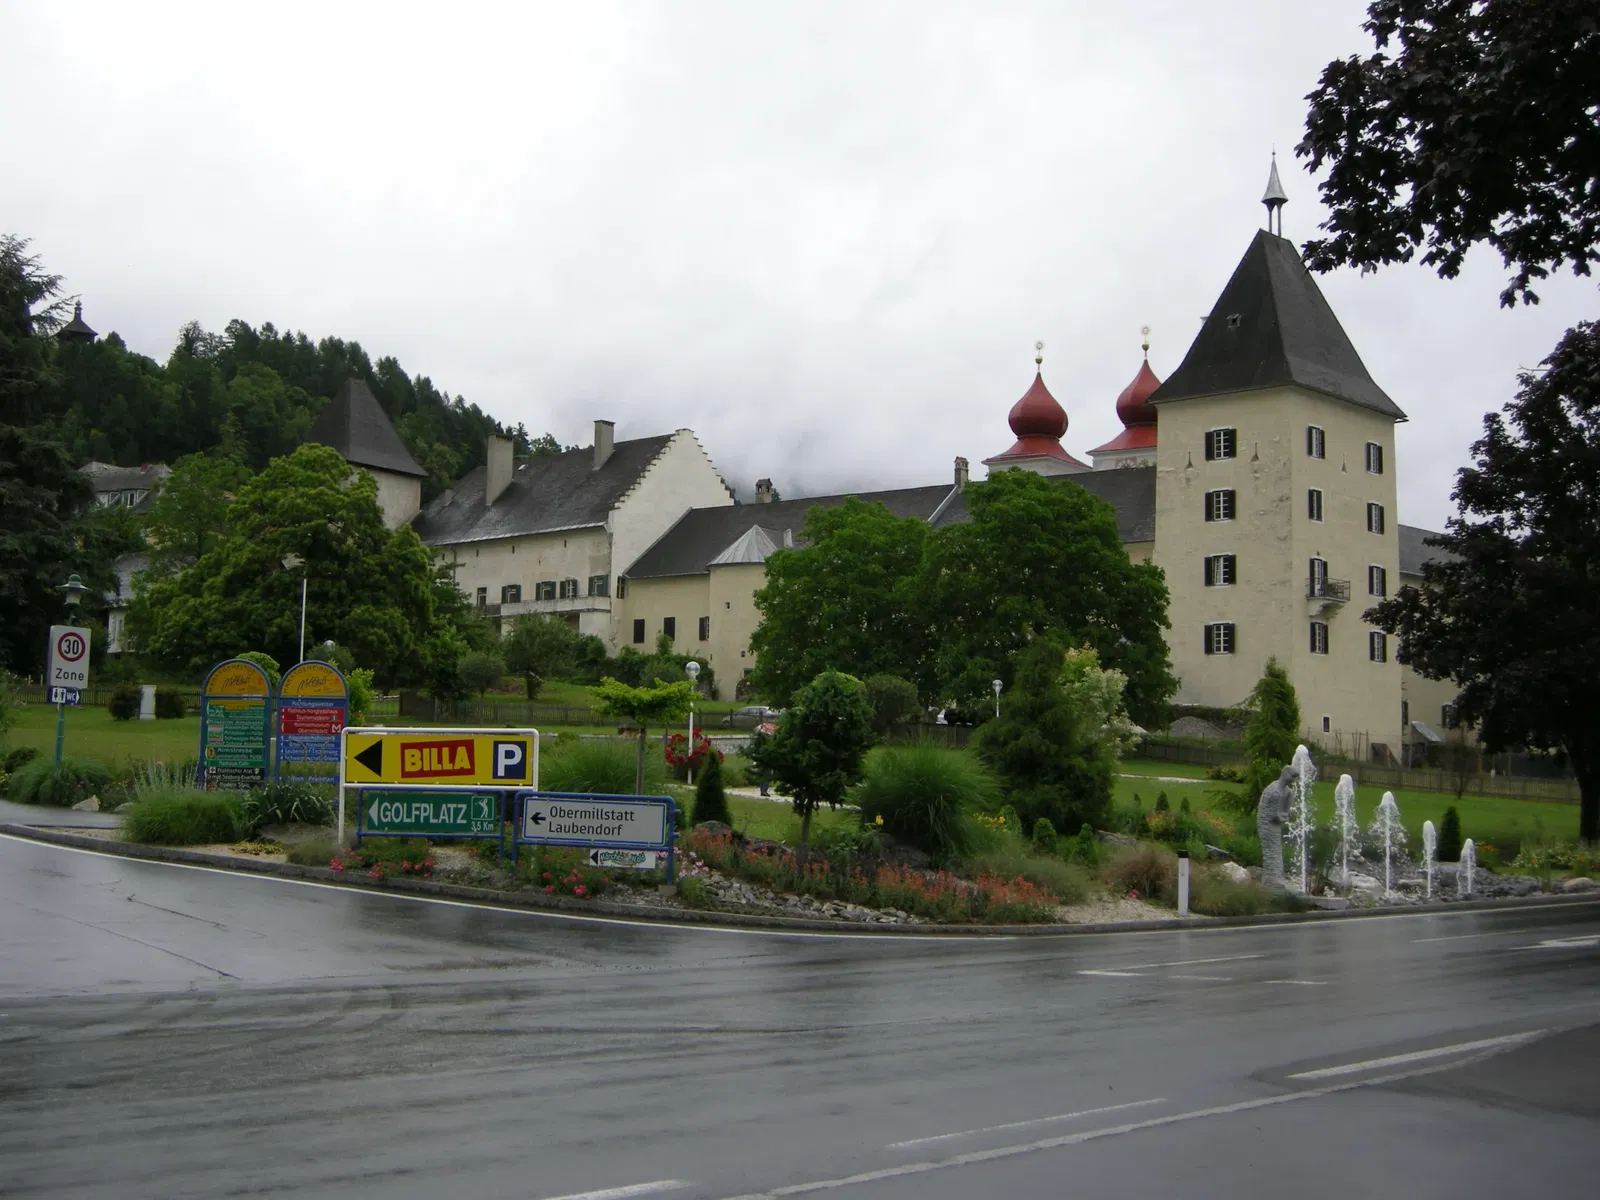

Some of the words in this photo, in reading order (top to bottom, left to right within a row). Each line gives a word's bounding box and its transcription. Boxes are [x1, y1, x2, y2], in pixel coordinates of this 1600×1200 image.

[64, 638, 79, 655] 30
[55, 667, 85, 681] Zone
[66, 692, 76, 701] WC
[404, 745, 472, 773] BILLA
[497, 743, 523, 777] P
[380, 801, 467, 824] GOLFPLATZ
[549, 805, 636, 822] Obermillstatt
[483, 821, 494, 831] Km
[548, 820, 624, 836] Laubendorf
